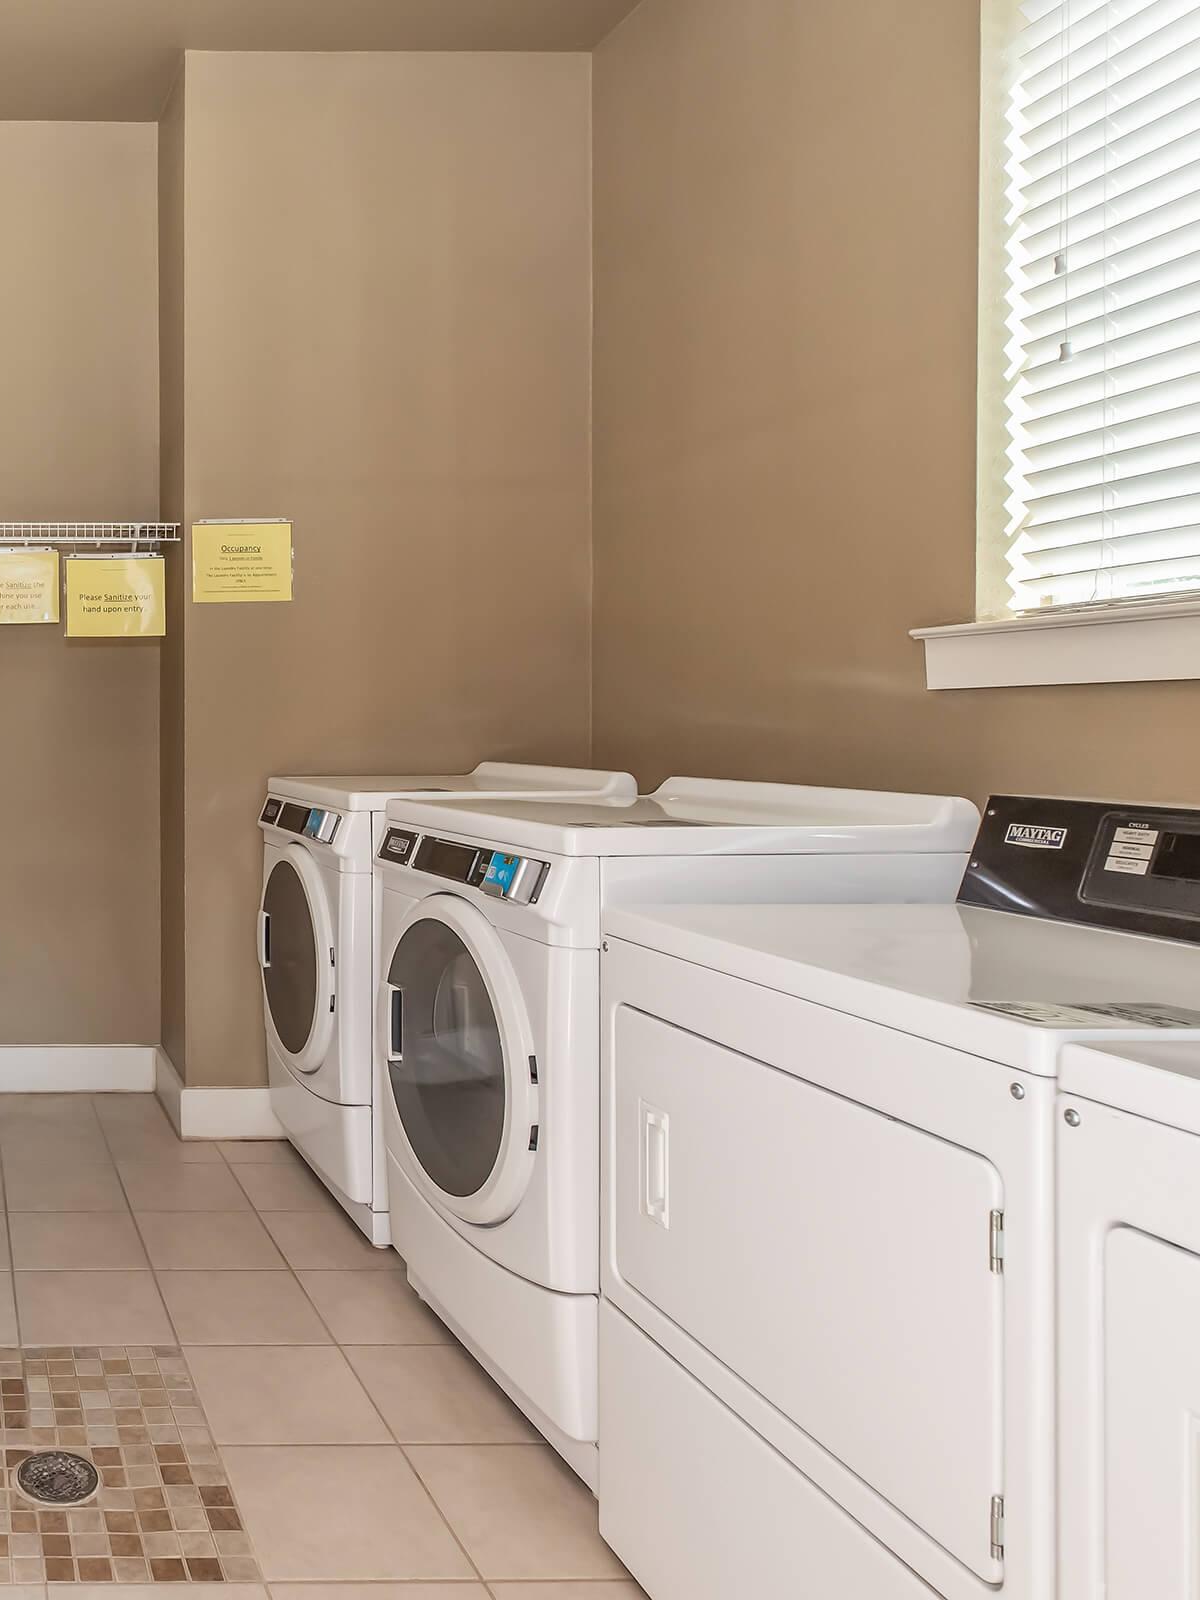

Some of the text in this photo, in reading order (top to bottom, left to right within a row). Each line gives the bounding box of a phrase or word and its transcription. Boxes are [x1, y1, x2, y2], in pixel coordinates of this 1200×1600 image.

[220, 544, 262, 553] Occupancy
[6, 581, 32, 589] Sanitize
[33, 581, 45, 589] the
[15, 593, 29, 601] you
[30, 592, 42, 600] use
[104, 594, 133, 602] Sanitize
[134, 594, 152, 603] your
[5, 602, 22, 610] each
[82, 604, 102, 613] hand
[103, 606, 122, 615] upon
[1010, 826, 1062, 841] MAYTAG
